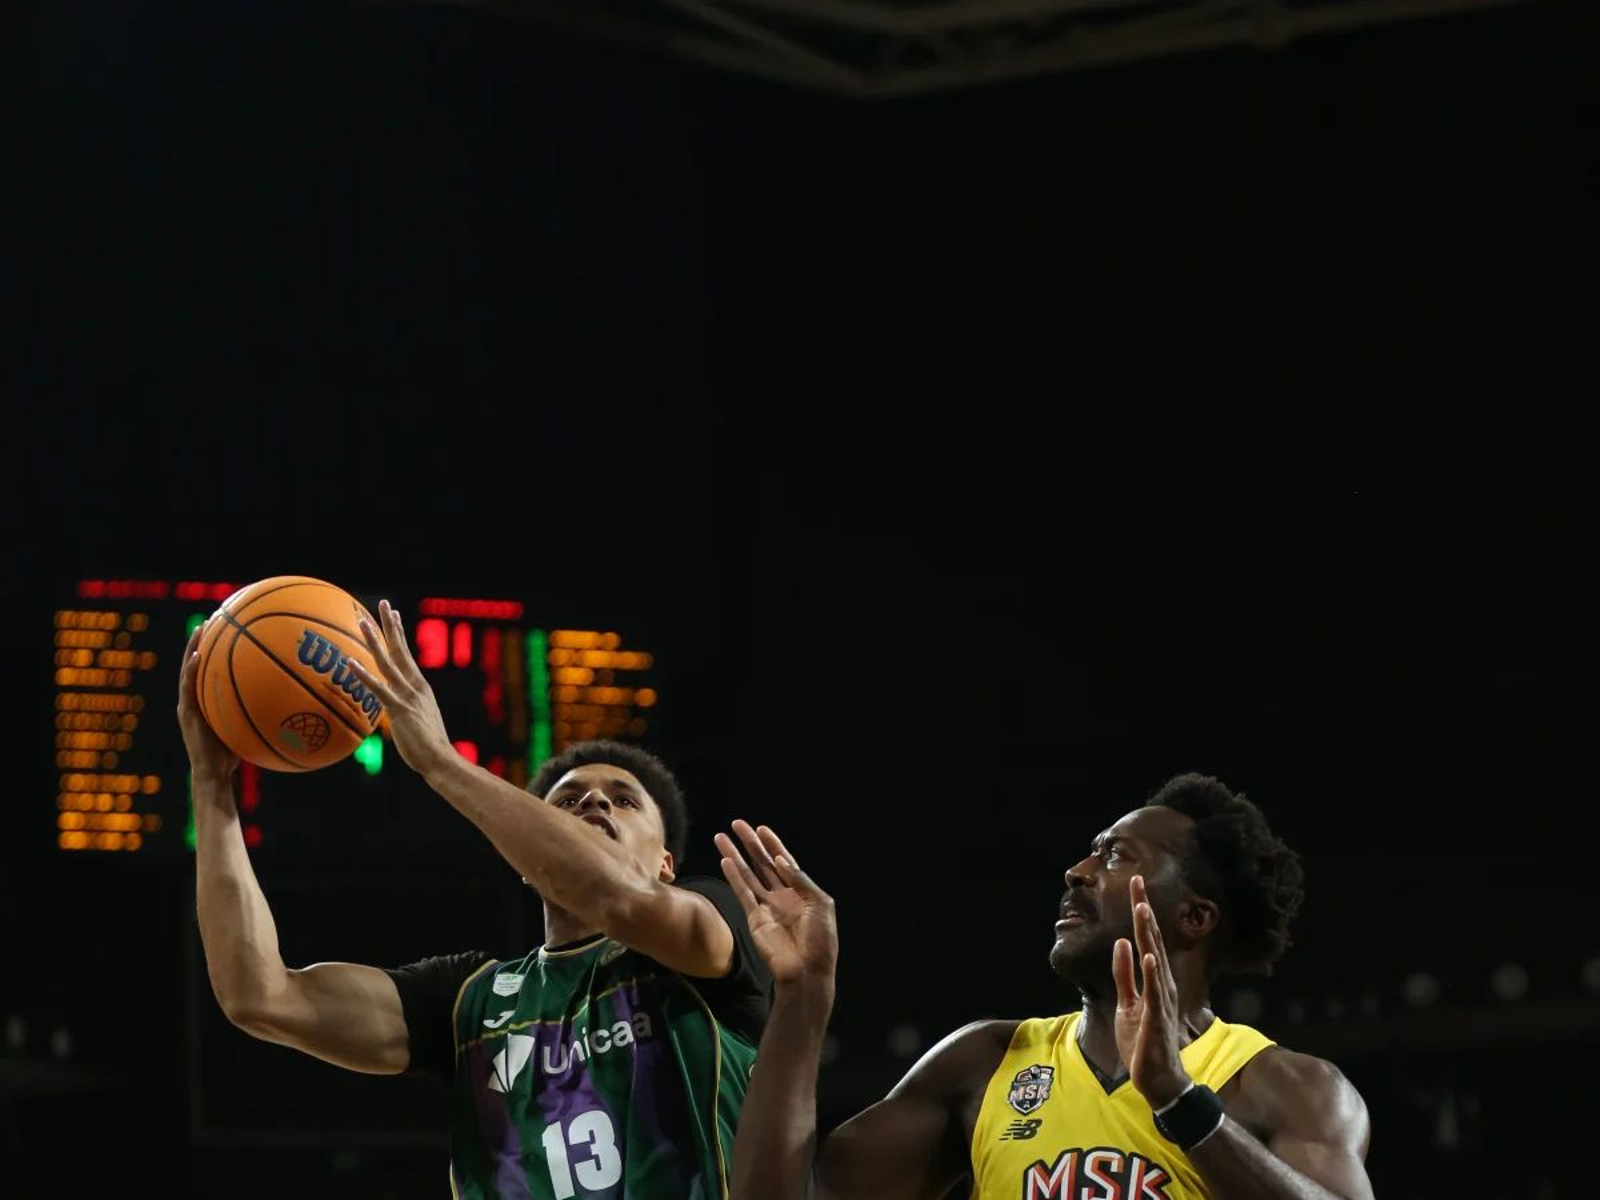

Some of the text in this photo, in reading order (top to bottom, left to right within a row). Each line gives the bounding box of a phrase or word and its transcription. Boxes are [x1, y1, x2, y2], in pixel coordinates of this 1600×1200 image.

[543, 1012, 652, 1074] Unicaa
[1008, 1084, 1049, 1103] MSK
[541, 1110, 622, 1200] 13
